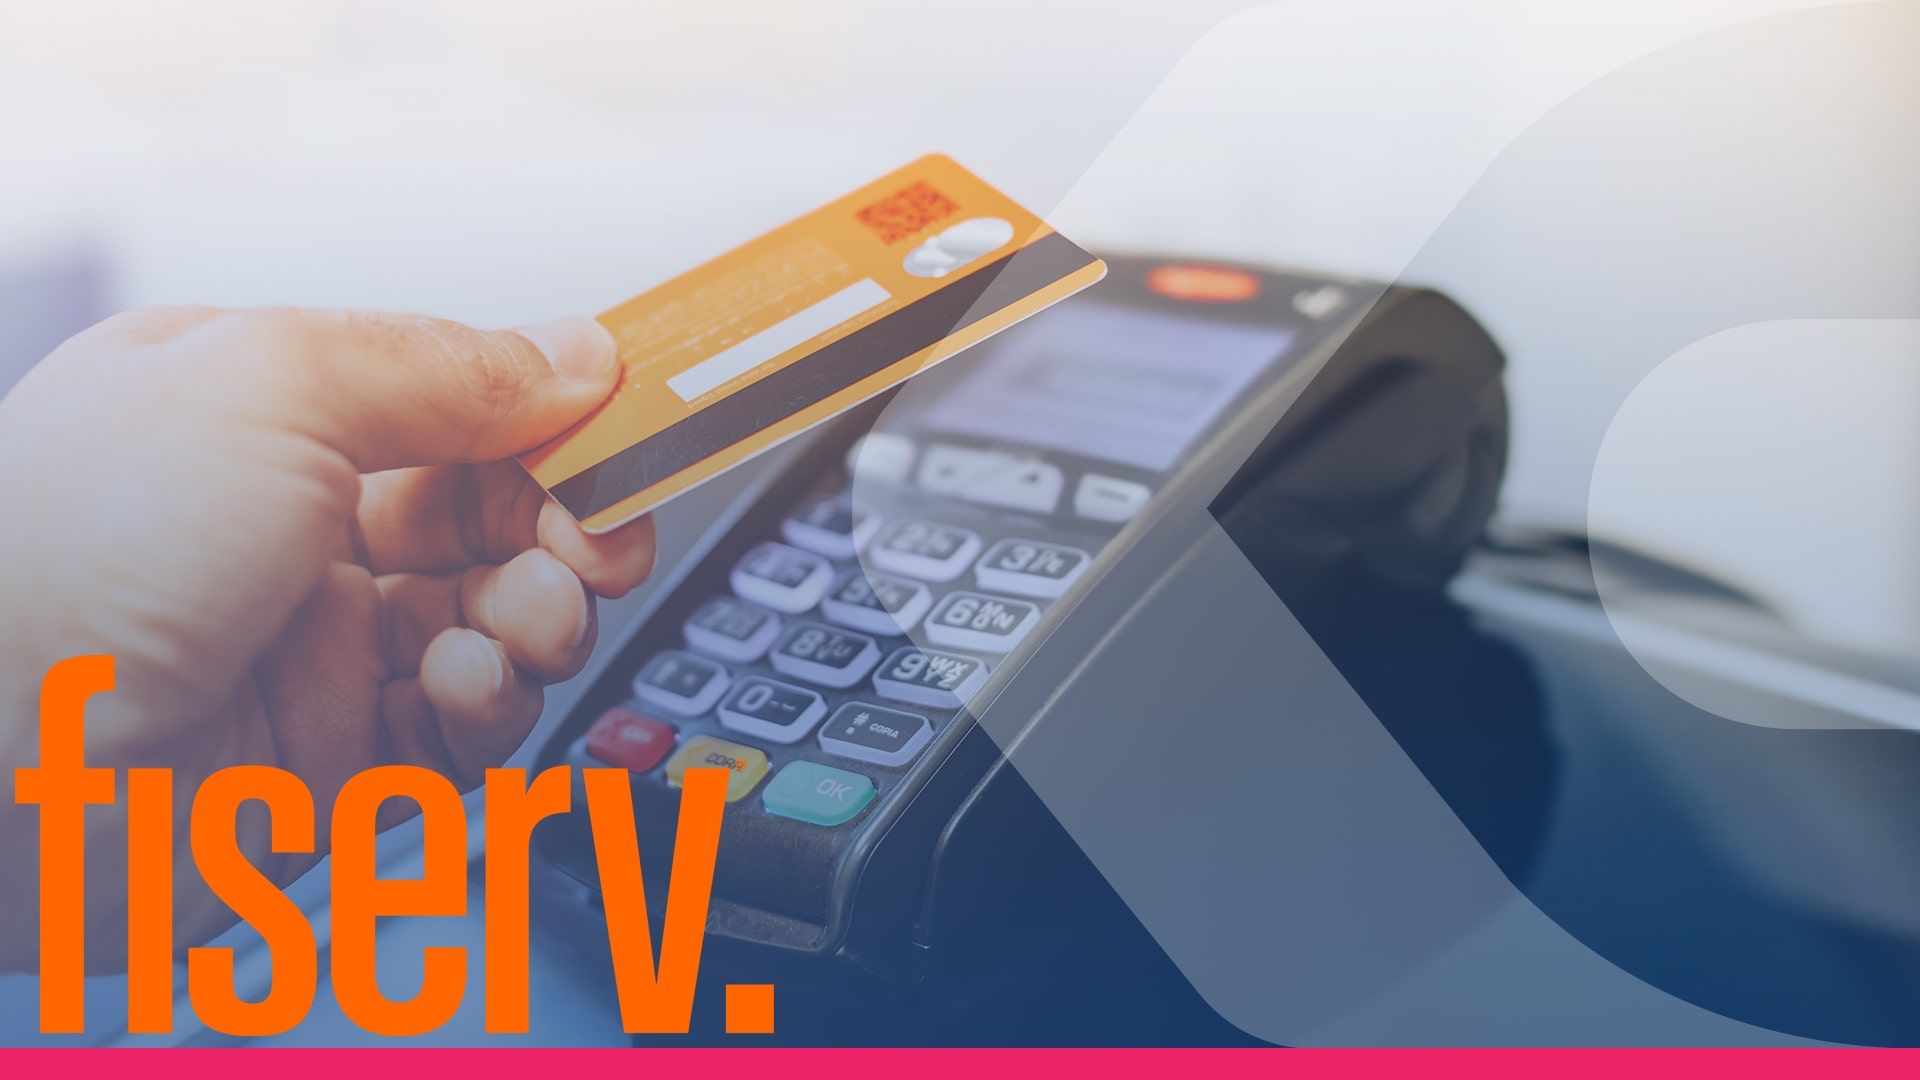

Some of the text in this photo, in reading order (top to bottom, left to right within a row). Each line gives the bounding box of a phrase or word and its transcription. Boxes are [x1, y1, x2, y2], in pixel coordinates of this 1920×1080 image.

[1001, 546, 1035, 571] 3
[944, 598, 979, 626] 6
[790, 629, 826, 658] 8
[892, 653, 929, 680] 9
[736, 684, 775, 712] 0
[869, 722, 900, 739] COPIA
[815, 778, 854, 802] OK
